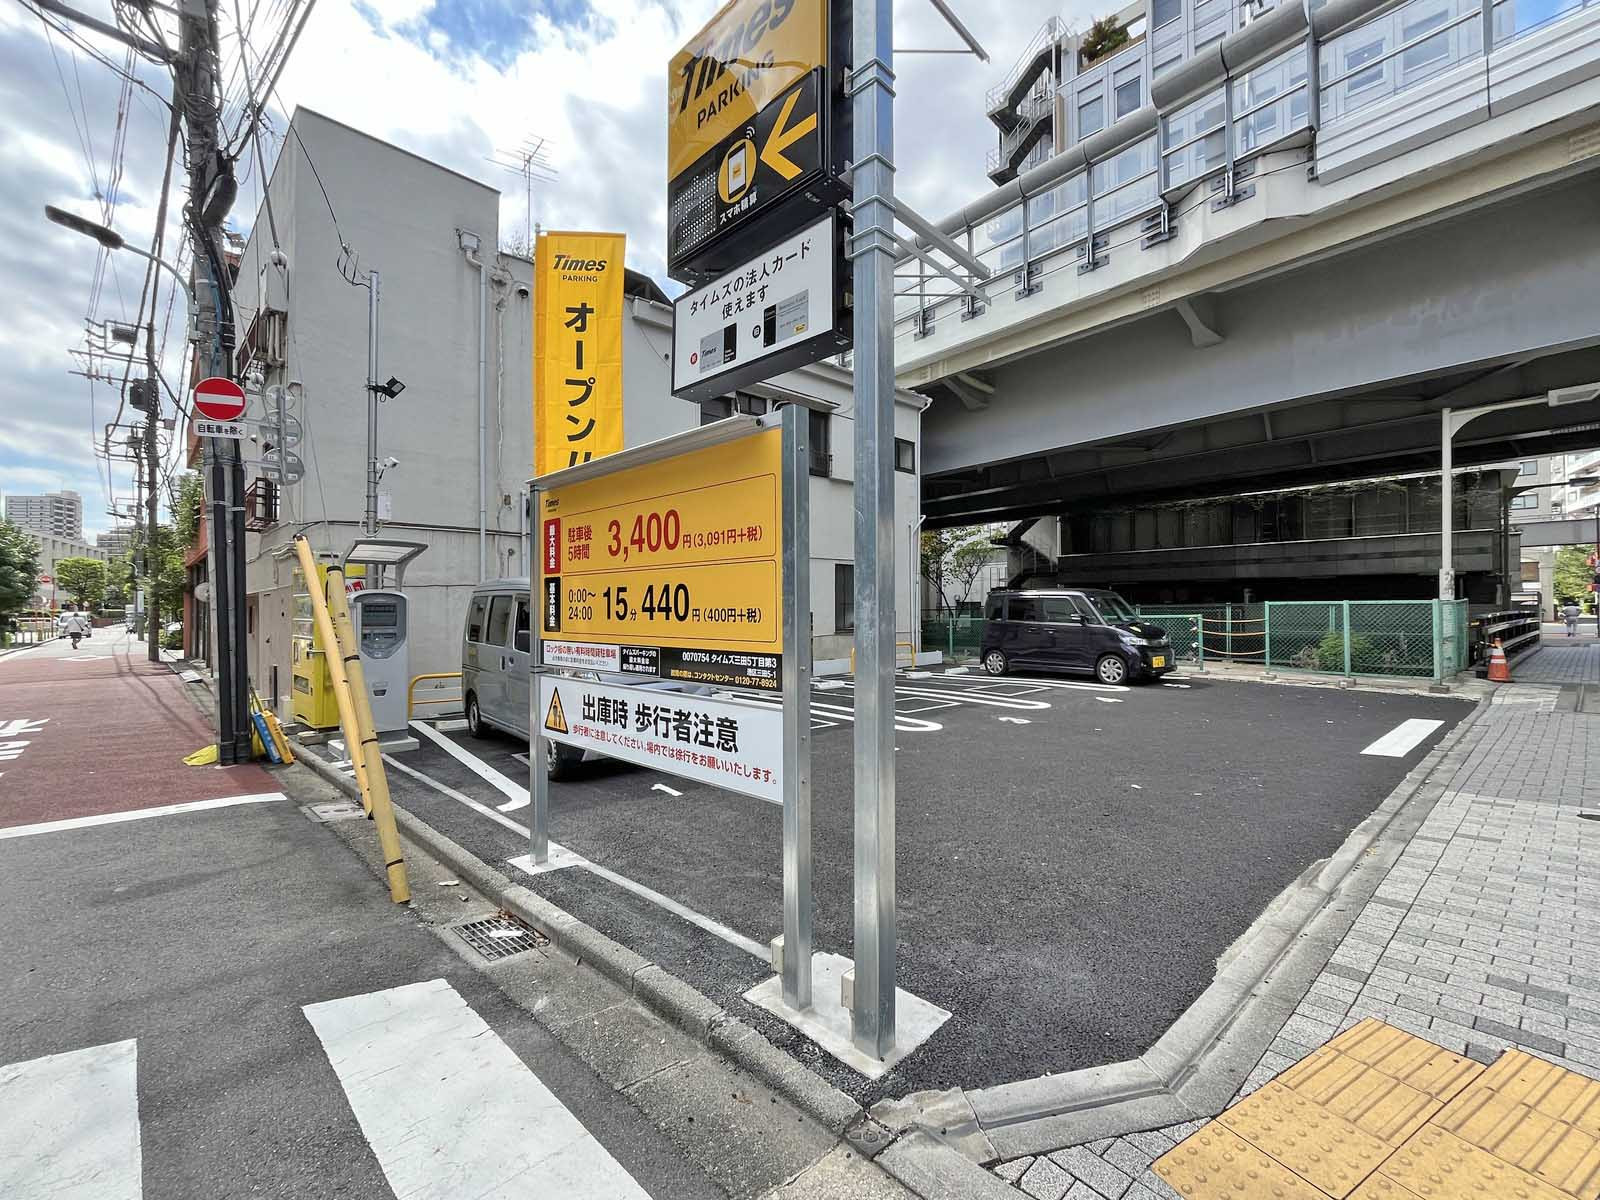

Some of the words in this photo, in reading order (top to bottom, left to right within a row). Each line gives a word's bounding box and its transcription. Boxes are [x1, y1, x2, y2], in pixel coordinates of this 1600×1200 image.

[680, 0, 796, 114] Times
[697, 50, 774, 129] PARKING
[553, 254, 607, 272] Times
[562, 275, 598, 283] PARKING
[690, 239, 811, 317] タイムズの法人カード
[721, 284, 769, 320] 使えます
[198, 424, 243, 435] 自転車を除く
[568, 525, 592, 543] 駐車後
[568, 544, 590, 562] 5時間
[568, 606, 593, 621] 24:00
[682, 652, 710, 663] 0070754
[582, 694, 629, 729] 出庫時
[635, 703, 739, 754] 歩行者注意
